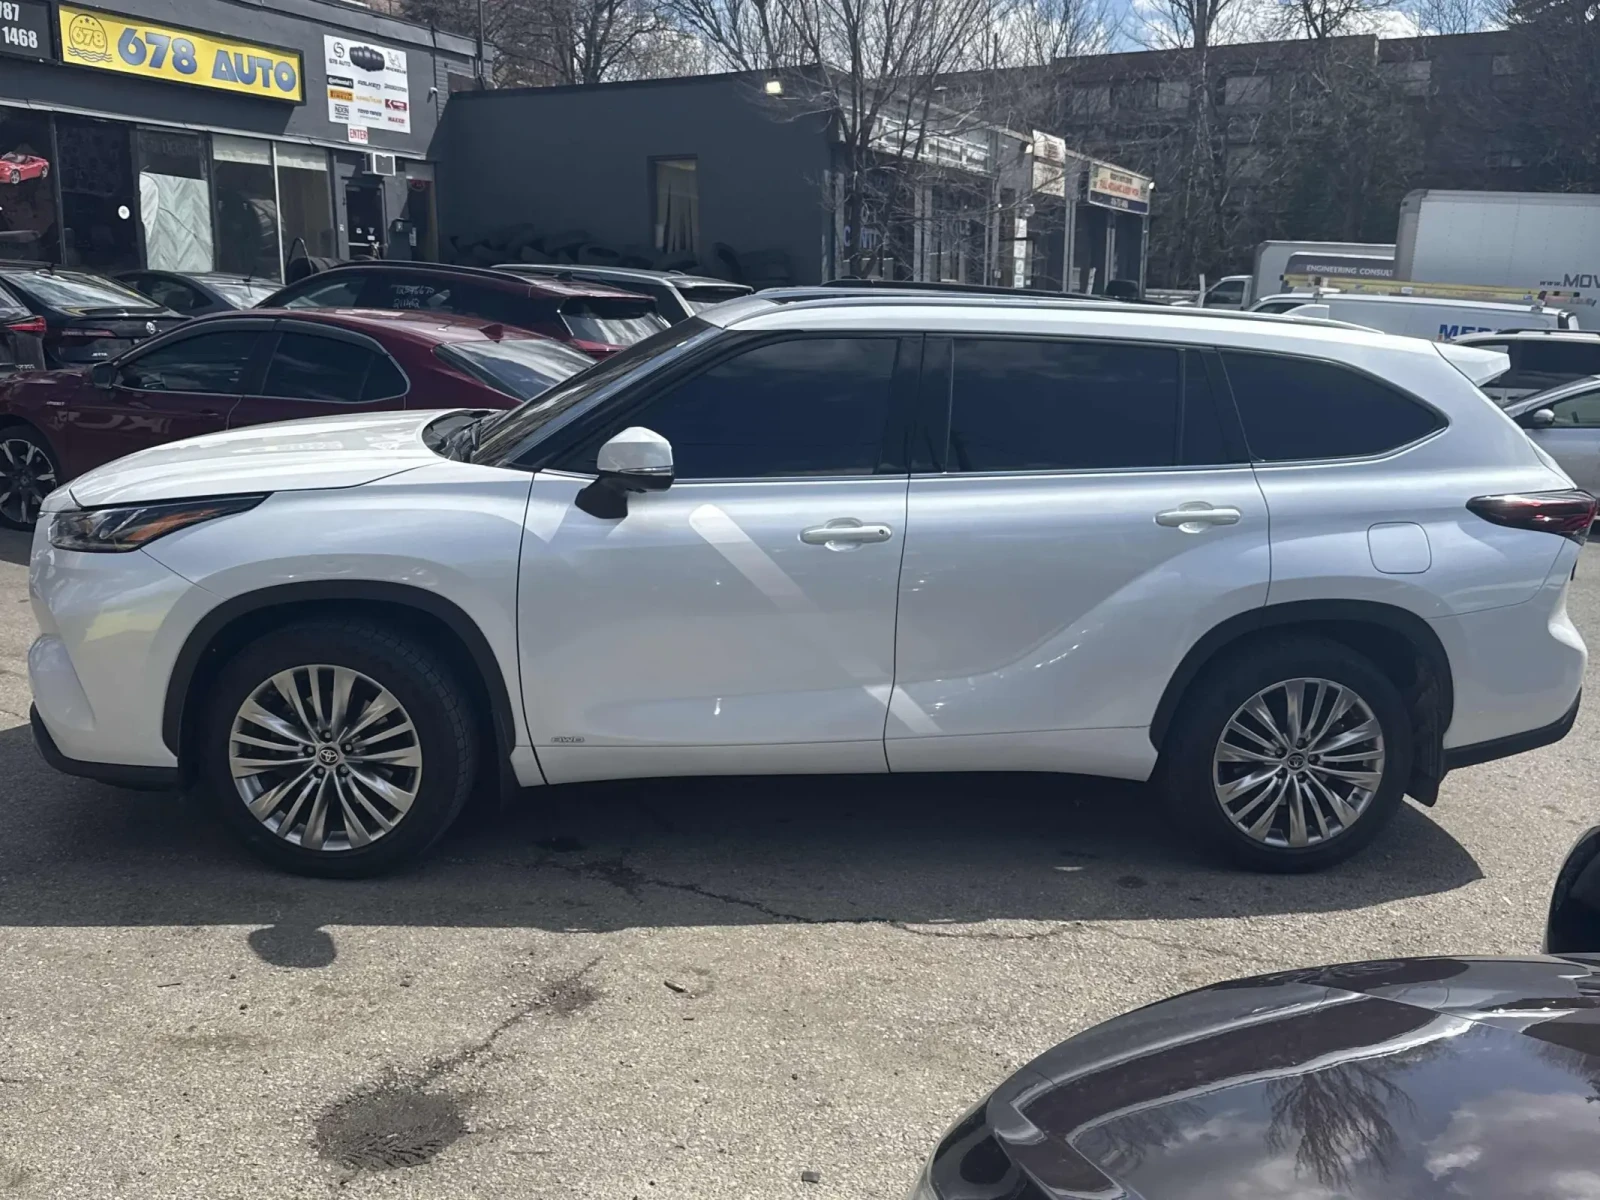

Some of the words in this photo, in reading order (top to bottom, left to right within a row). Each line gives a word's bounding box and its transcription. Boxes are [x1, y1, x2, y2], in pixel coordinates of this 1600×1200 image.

[0, 1, 19, 21] 87
[2, 26, 38, 48] 1468
[71, 26, 105, 48] 678
[118, 28, 198, 75] 678
[211, 49, 297, 93] AUTO
[349, 128, 368, 140] ENTER
[1306, 264, 1357, 275] ENGINEERING
